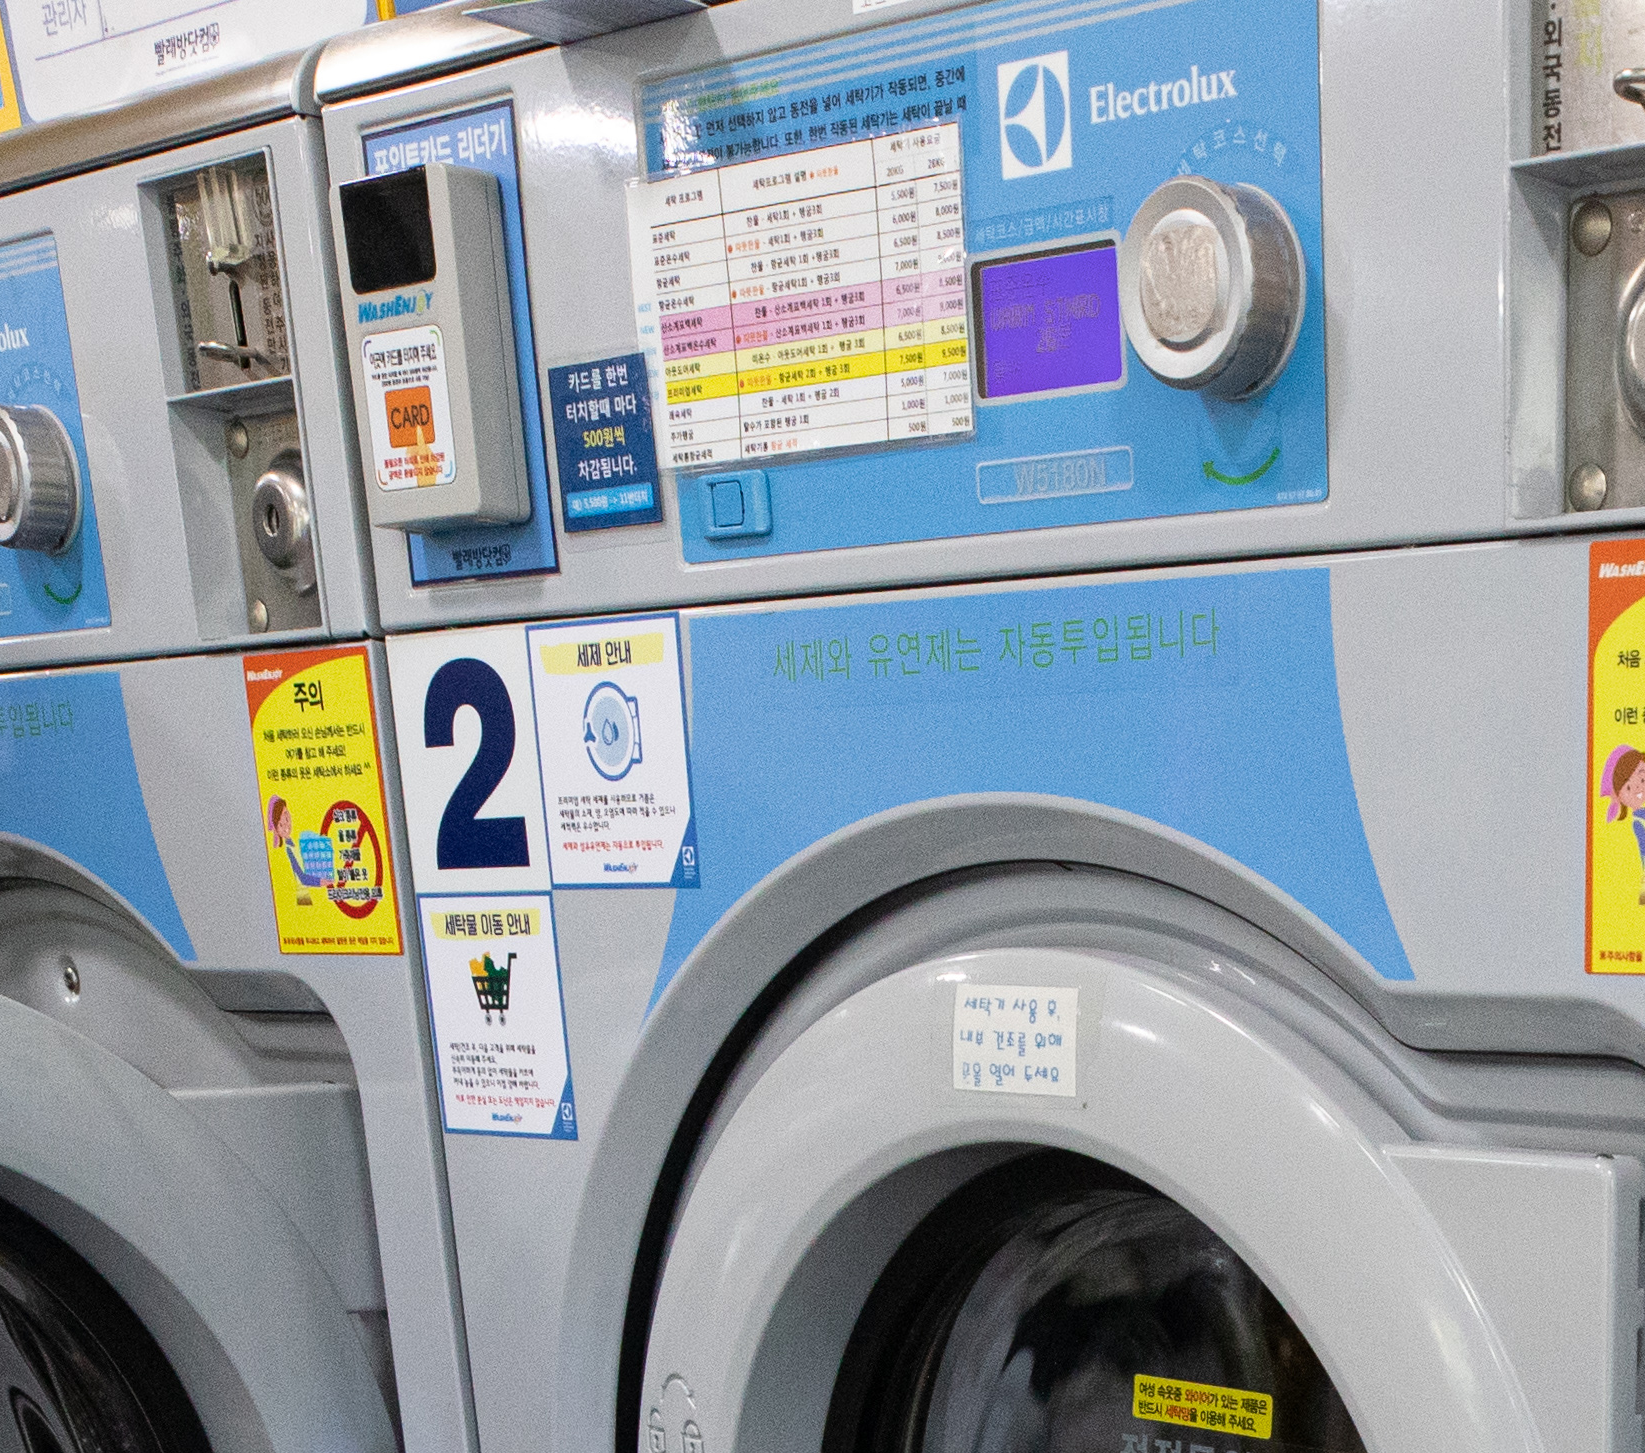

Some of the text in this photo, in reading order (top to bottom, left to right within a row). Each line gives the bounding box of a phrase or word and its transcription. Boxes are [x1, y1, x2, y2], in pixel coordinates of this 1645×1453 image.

[1089, 65, 1238, 125] Electrolux
[457, 119, 507, 163] 리더기
[568, 364, 628, 392] 카드를 한번
[390, 404, 430, 430] CARD
[566, 394, 637, 423] 터치할때 마다
[583, 427, 625, 448] 500원씩
[578, 454, 638, 481] 차감됩니다.
[576, 640, 632, 669] 세제 안내
[772, 607, 1221, 684] 세제와 유연제는 자동투입됩니다
[1617, 649, 1641, 668] 처음
[293, 680, 324, 712] 주의
[1615, 707, 1638, 724] 이런
[423, 657, 531, 871] 2
[444, 911, 532, 937] 세탁물 이동 안내
